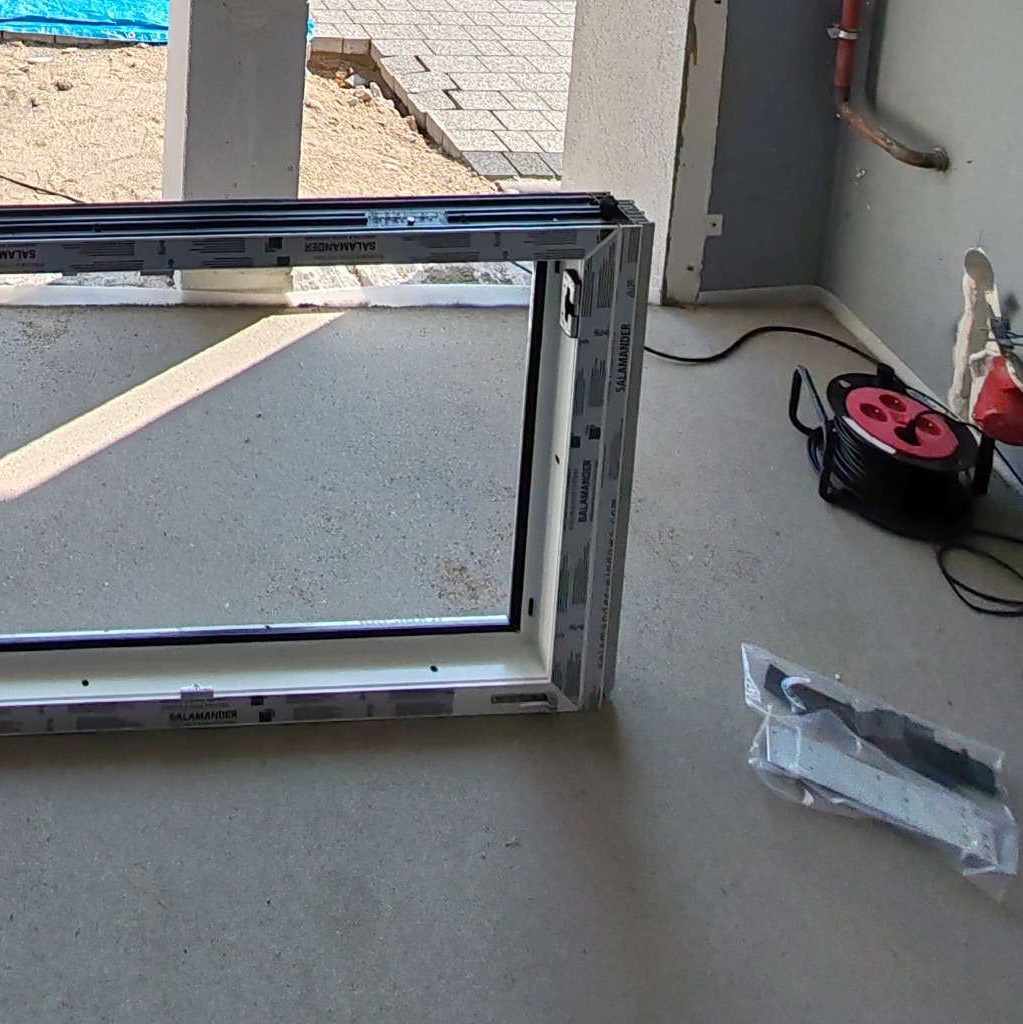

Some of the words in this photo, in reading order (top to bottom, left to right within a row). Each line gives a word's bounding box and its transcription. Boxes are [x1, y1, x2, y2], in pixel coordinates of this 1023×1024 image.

[305, 241, 376, 252] SALAMANDER
[615, 323, 631, 392] SALAMANDER
[578, 460, 592, 522] SALAMANDER
[169, 710, 238, 721] SALAMANDER
